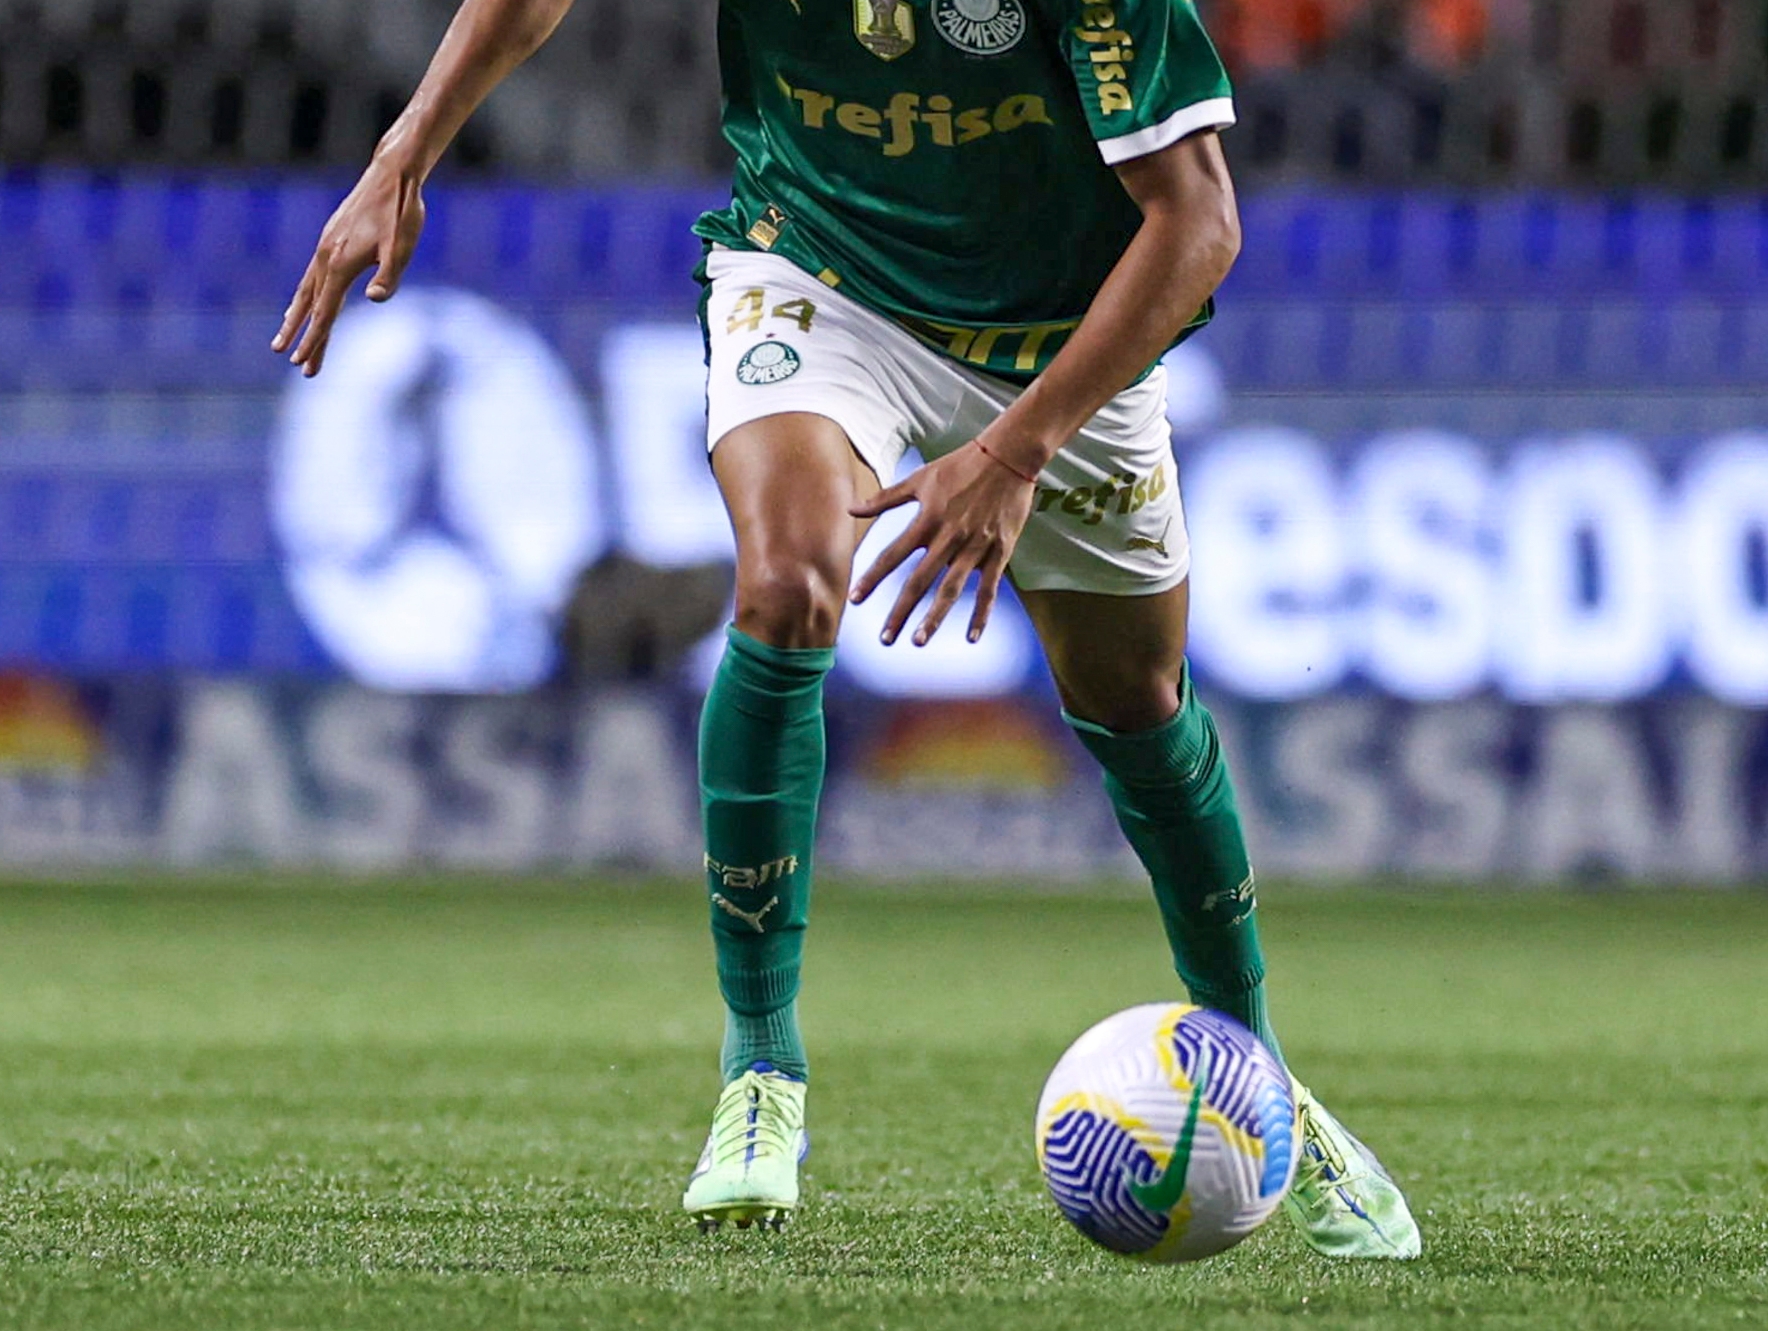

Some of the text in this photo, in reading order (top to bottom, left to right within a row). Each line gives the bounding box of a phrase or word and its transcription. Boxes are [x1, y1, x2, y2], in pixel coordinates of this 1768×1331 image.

[938, 9, 1020, 49] PALMEIRAS
[776, 73, 1054, 157] refisa
[727, 288, 816, 335] 44
[1035, 461, 1167, 526] refisa
[163, 680, 703, 867] ASSA
